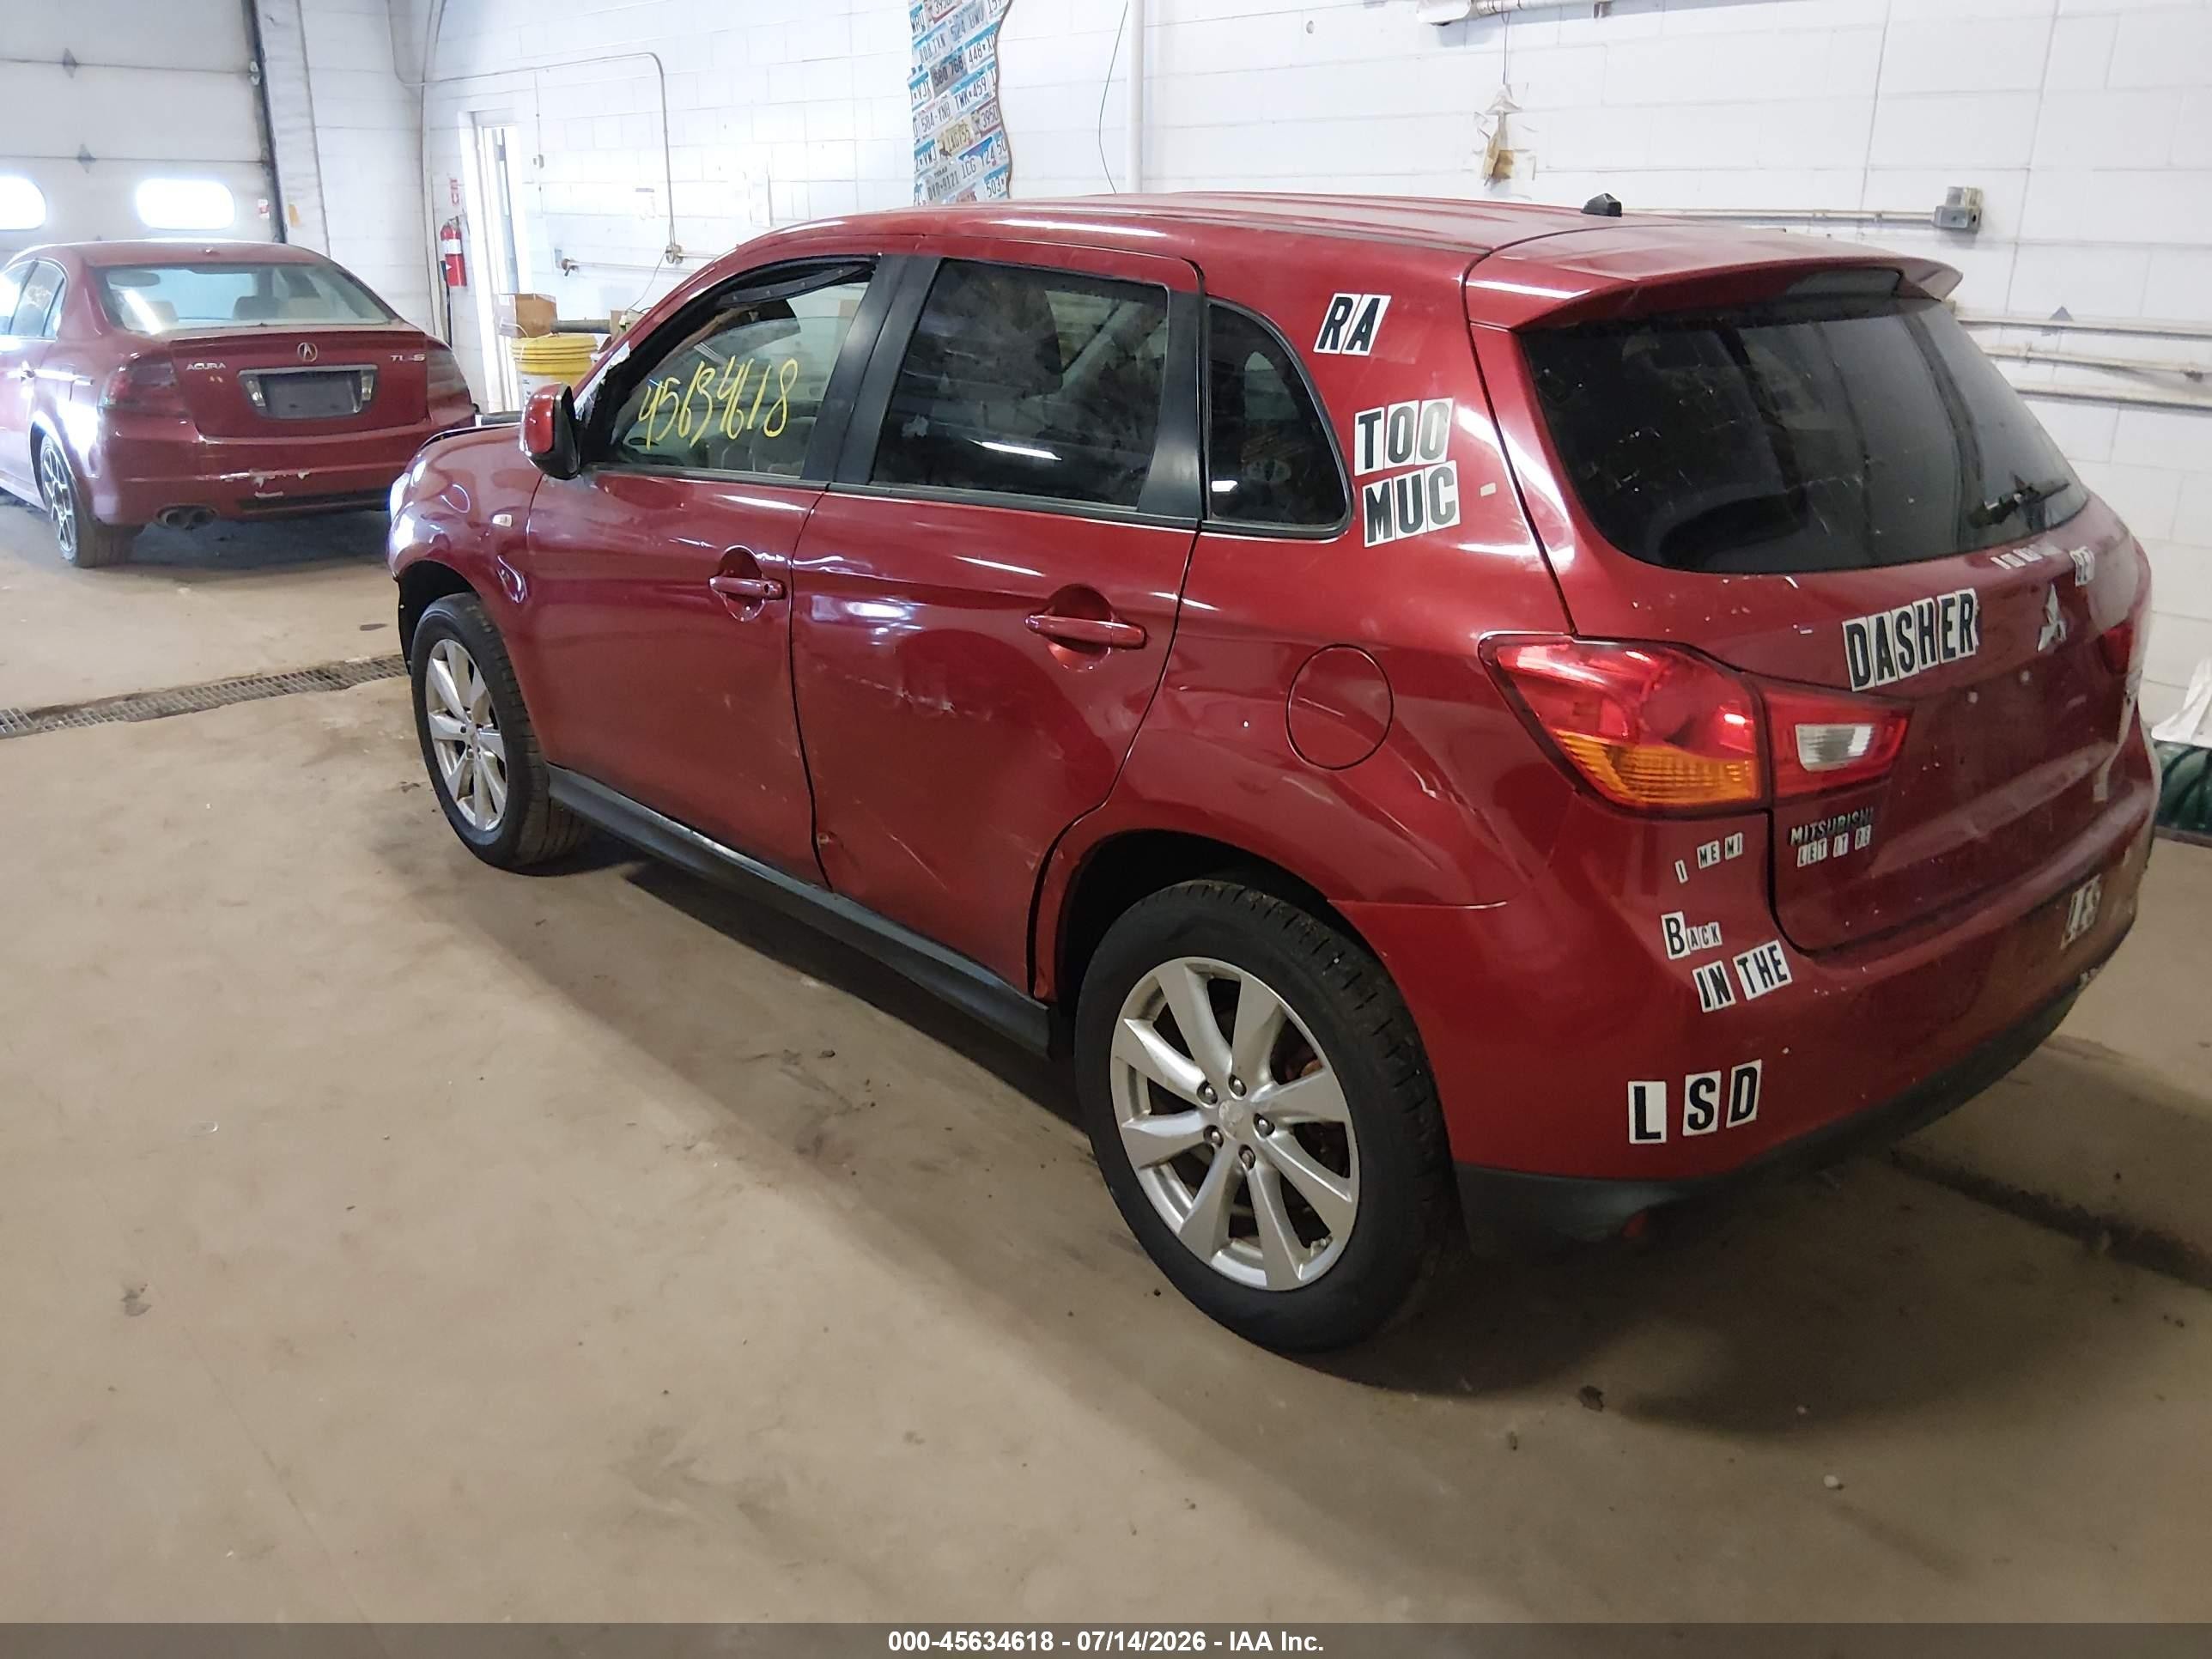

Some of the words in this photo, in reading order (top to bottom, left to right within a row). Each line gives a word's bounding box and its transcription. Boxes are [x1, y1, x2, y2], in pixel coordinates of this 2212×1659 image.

[1317, 296, 1381, 352] RA
[185, 362, 226, 371] ACURA
[638, 356, 798, 451] 45634618
[1358, 402, 1449, 470] TOO
[1365, 466, 1457, 544] MUC
[1845, 592, 1975, 688] DASHER
[1698, 843, 1718, 867] ME
[1790, 806, 1874, 847] MITSUBISHI
[1798, 839, 1826, 866] LET
[1696, 964, 1732, 1009] IN
[1736, 945, 1789, 994] THE
